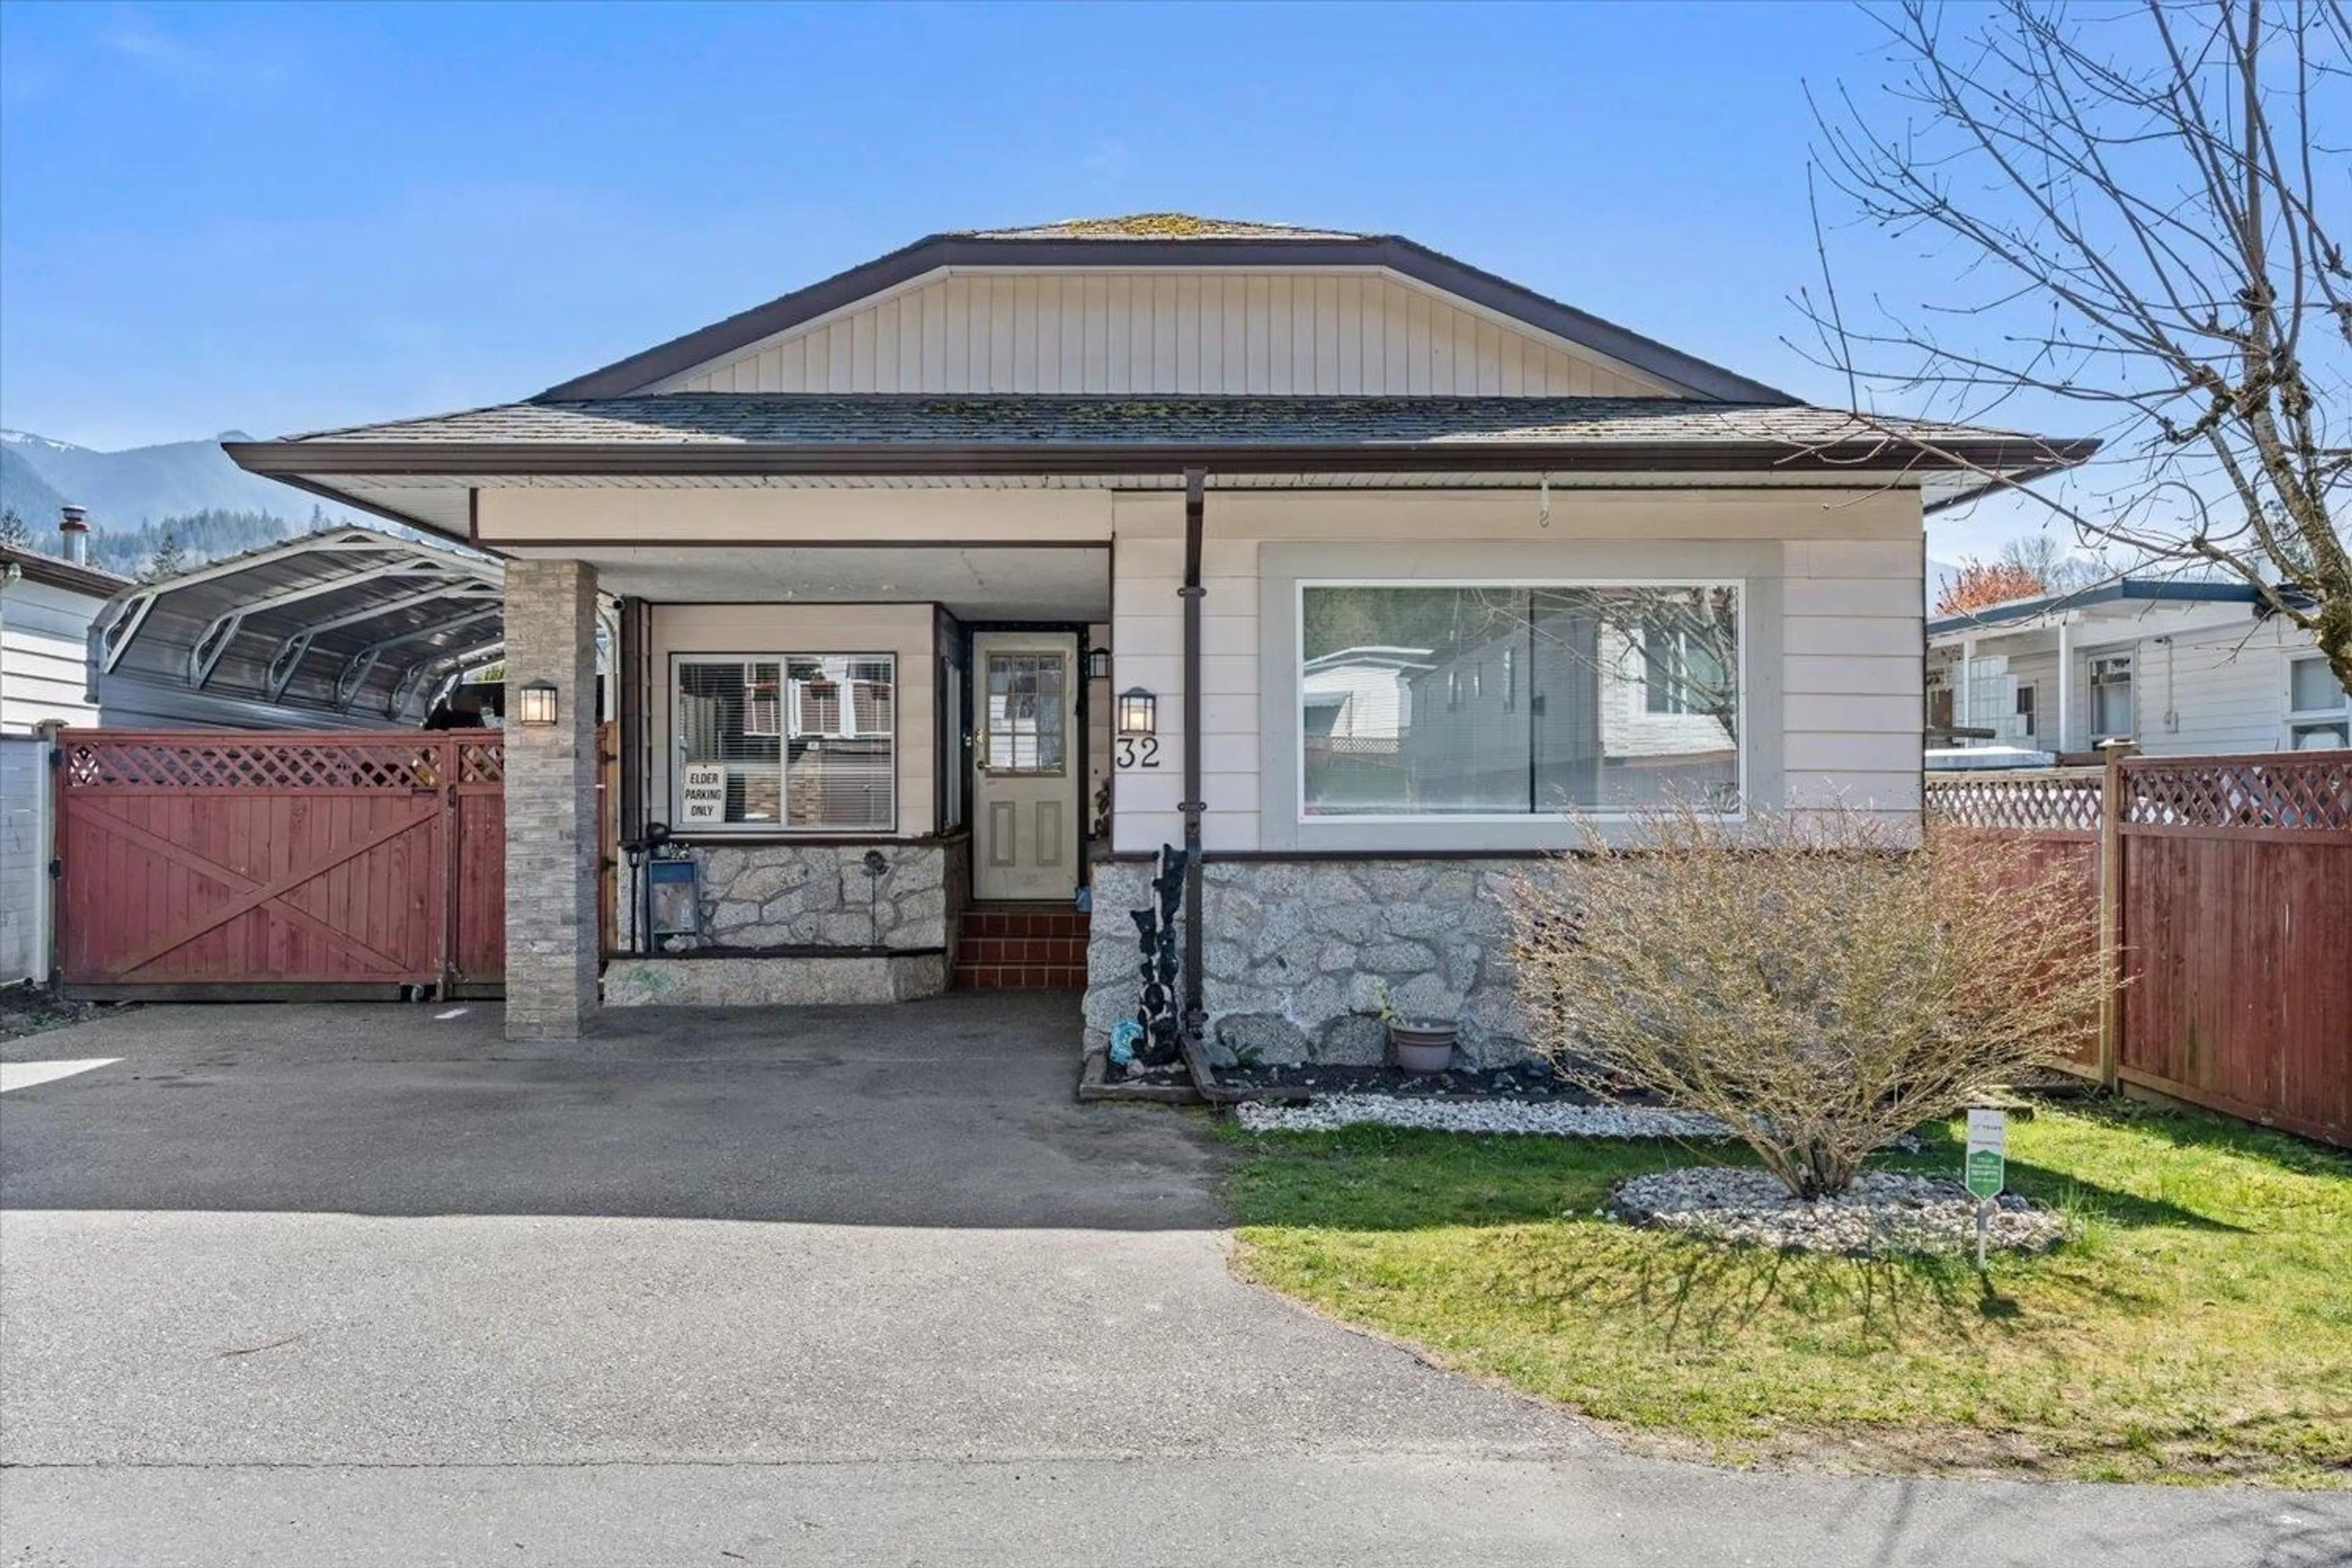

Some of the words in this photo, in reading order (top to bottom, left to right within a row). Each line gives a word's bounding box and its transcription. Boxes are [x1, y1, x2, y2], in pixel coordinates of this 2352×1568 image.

[1117, 737, 1159, 769] 32
[690, 773, 719, 784] ELDER
[685, 789, 722, 800] PARKING
[691, 805, 714, 816] ONLY
